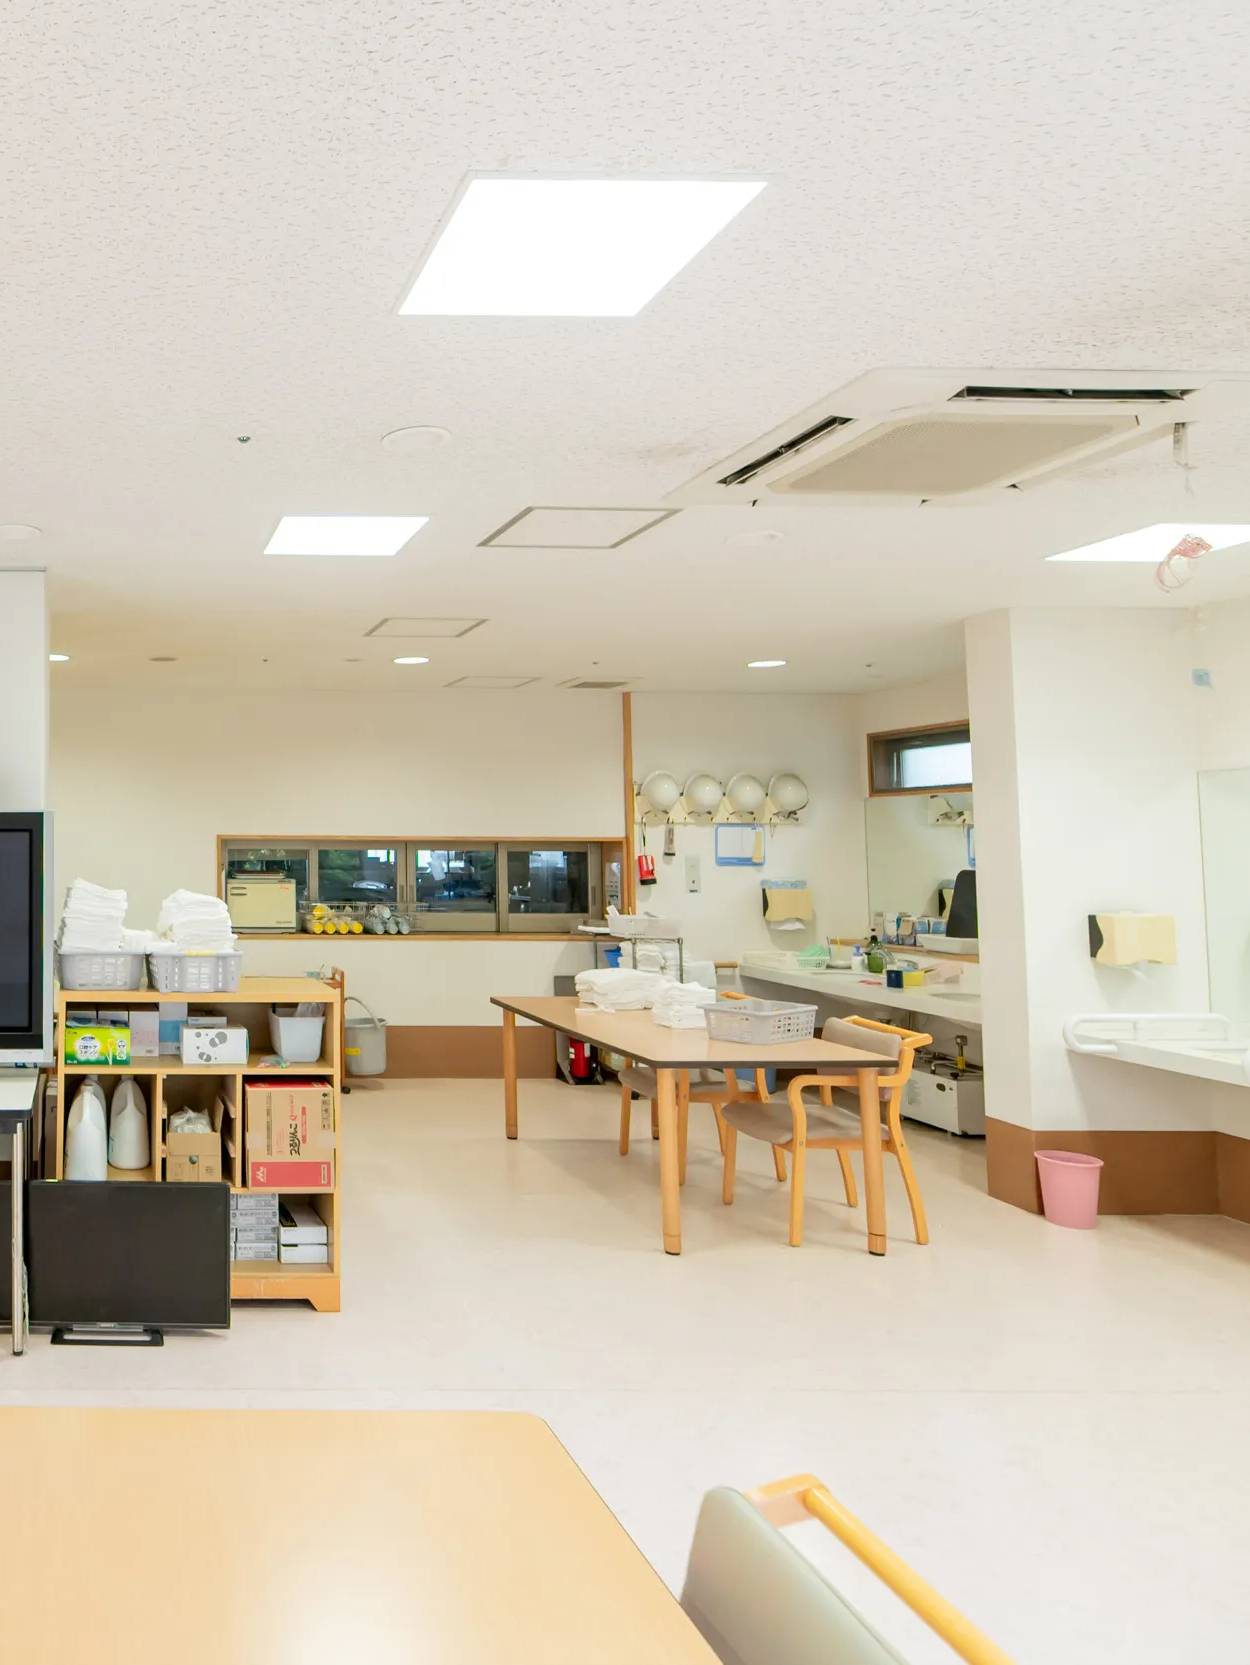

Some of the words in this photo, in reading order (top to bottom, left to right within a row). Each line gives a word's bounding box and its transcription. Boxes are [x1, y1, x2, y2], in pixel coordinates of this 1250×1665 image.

[289, 1123, 301, 1156] つるりんこ
